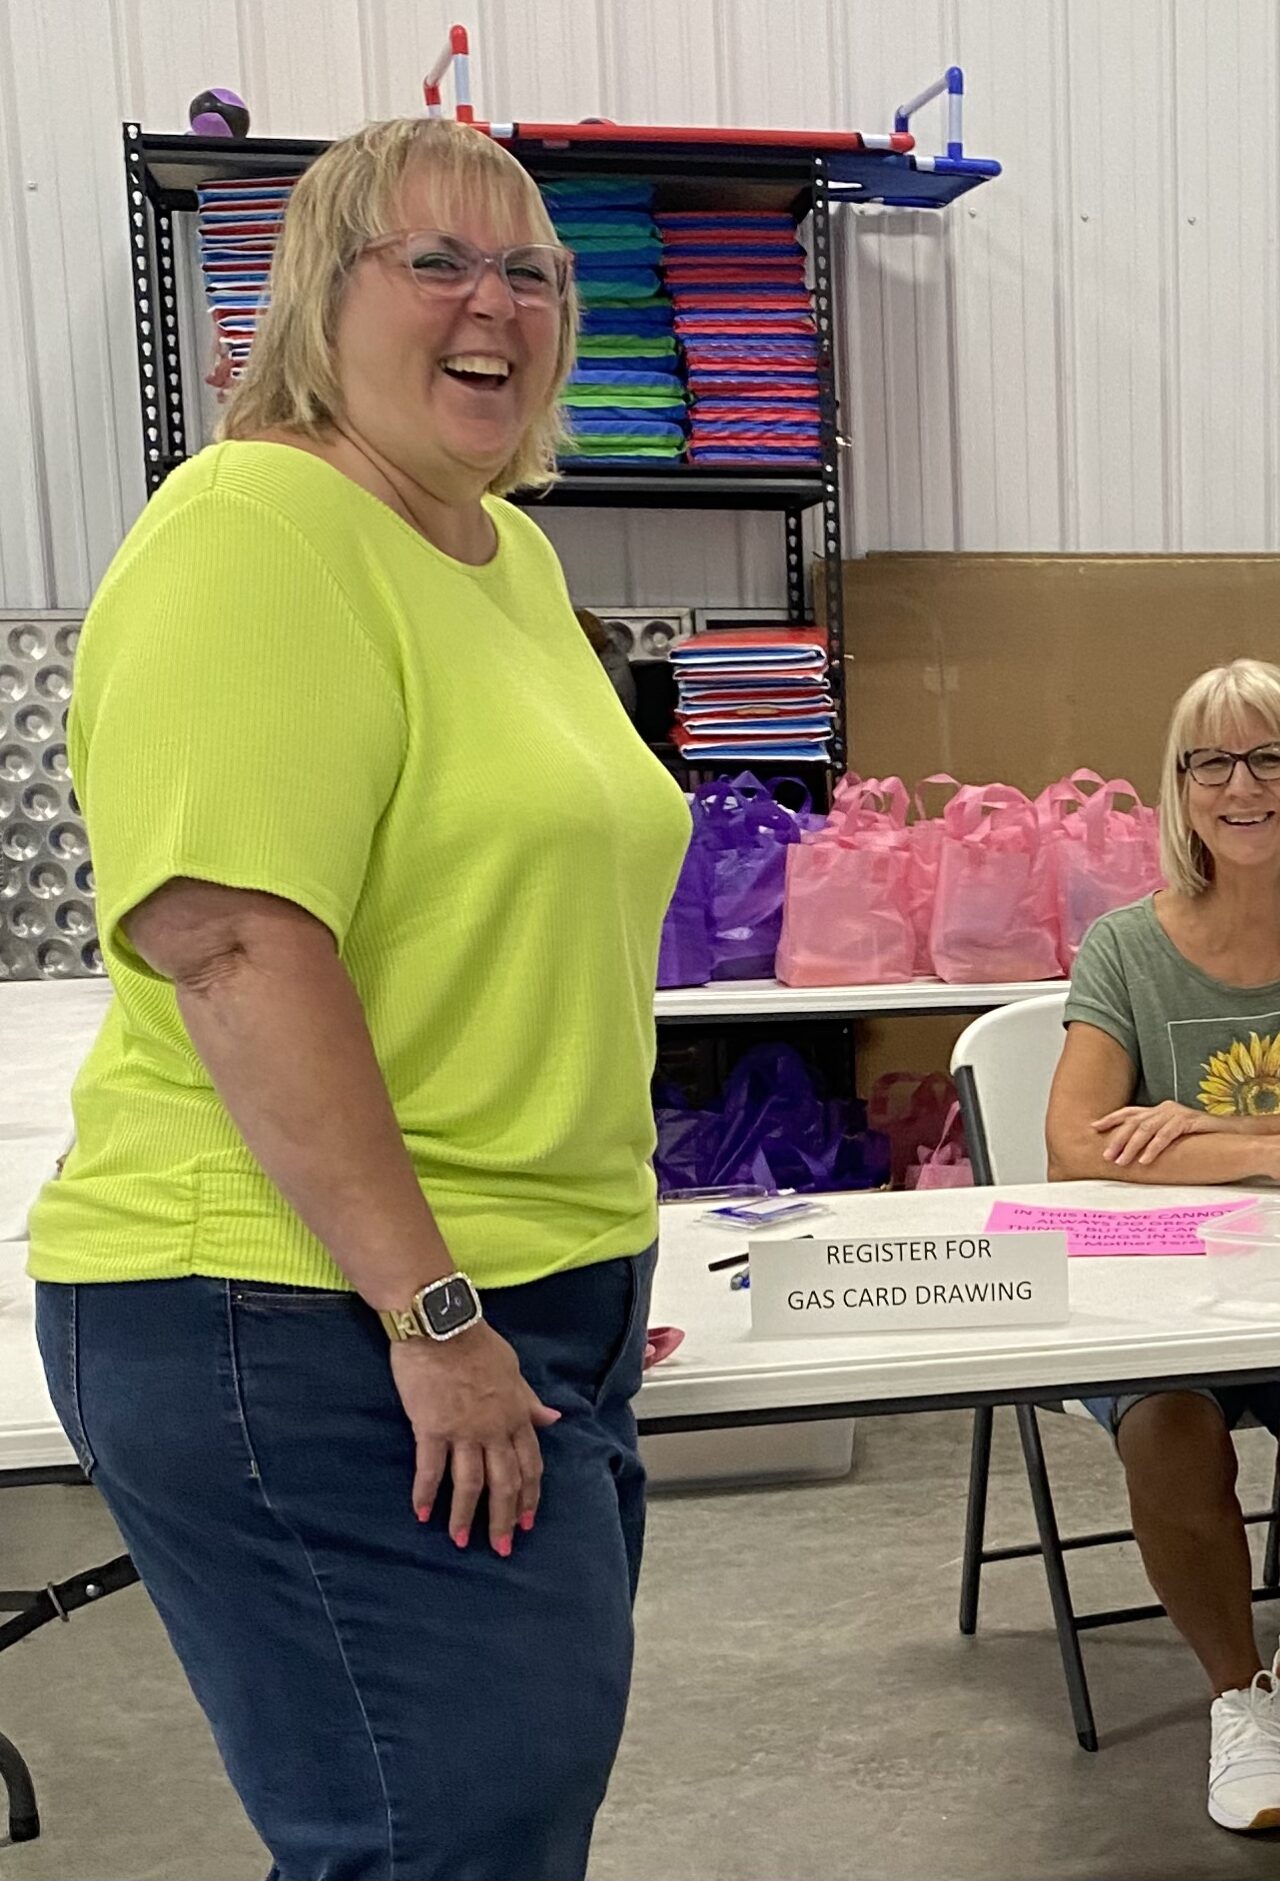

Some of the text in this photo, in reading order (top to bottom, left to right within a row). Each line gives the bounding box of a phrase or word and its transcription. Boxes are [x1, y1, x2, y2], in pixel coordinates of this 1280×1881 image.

[1014, 1208, 1032, 1216] IN
[1041, 1210, 1078, 1218] THIS
[1083, 1212, 1118, 1220] LIFE
[1034, 1219, 1111, 1227] ALWAYS
[826, 1239, 993, 1265] REGISTER FOR
[787, 1280, 1033, 1311] GAS CARD DRAWING
